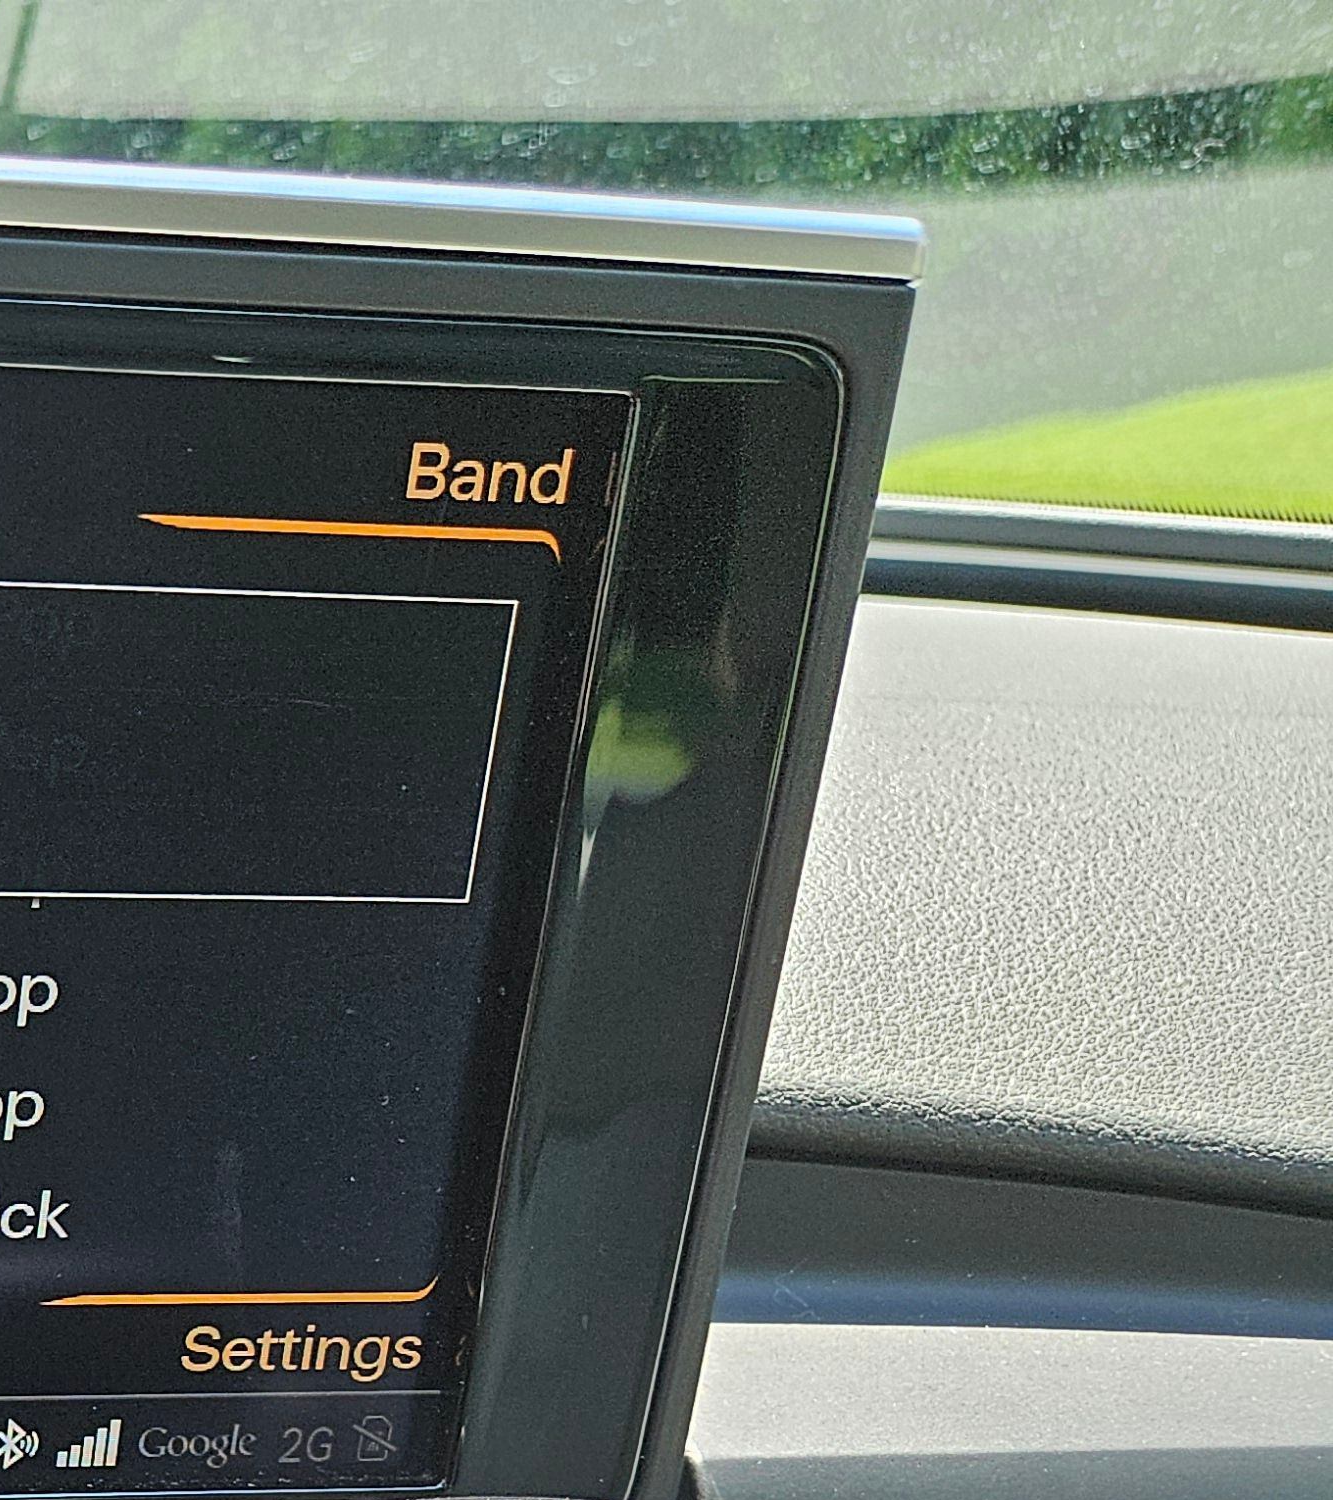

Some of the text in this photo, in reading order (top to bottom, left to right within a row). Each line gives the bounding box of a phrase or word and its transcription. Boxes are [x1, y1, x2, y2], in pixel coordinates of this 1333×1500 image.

[405, 442, 577, 505] Band
[180, 1324, 422, 1382] Settings
[138, 1423, 334, 1469] Google 2G
